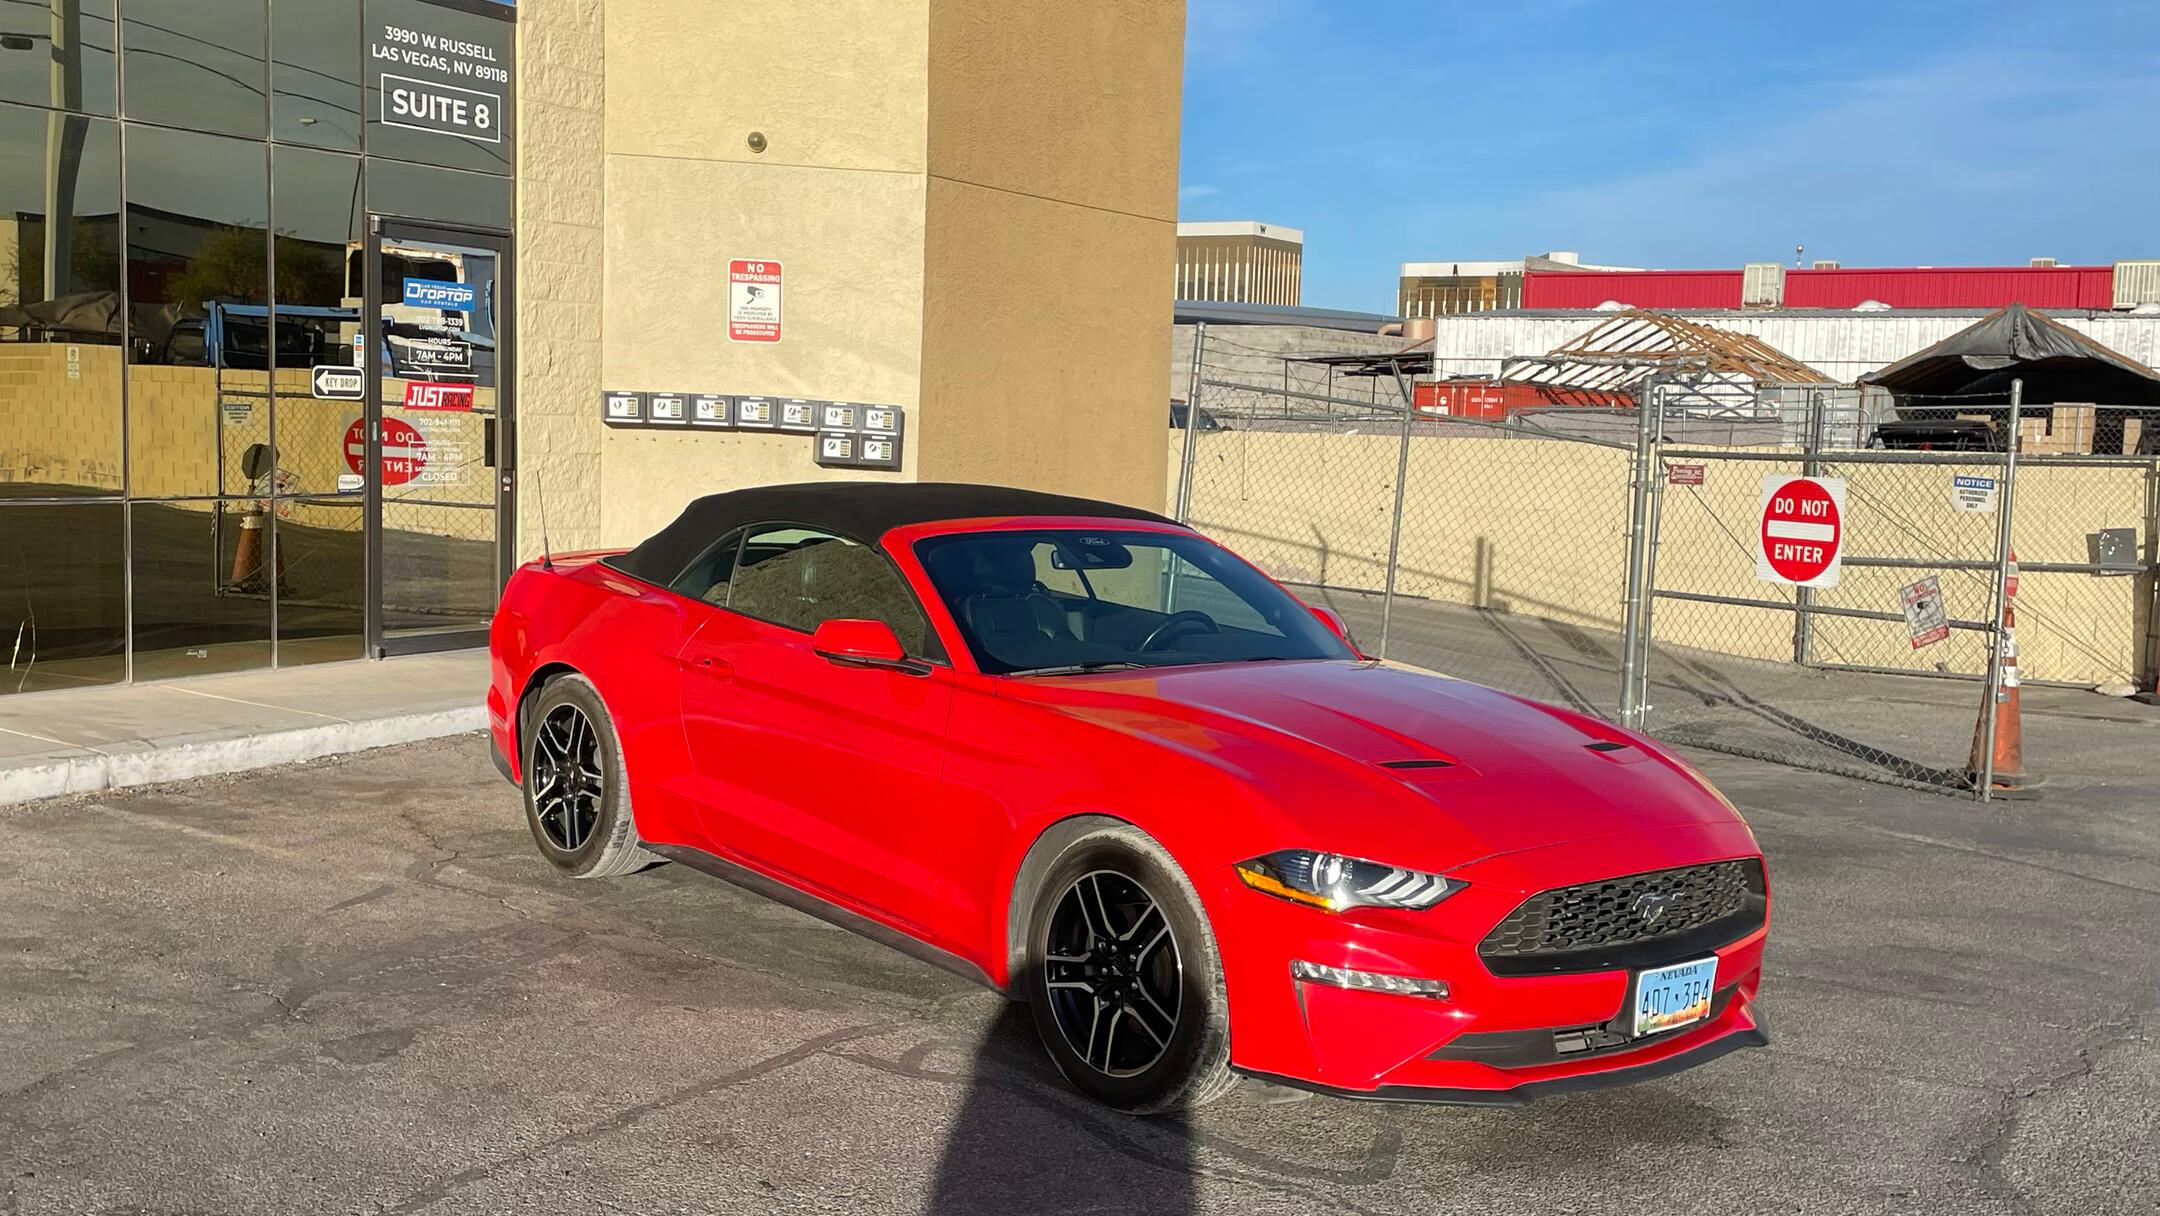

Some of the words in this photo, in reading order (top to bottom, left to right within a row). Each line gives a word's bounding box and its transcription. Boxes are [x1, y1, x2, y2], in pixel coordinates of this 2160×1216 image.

[384, 25, 418, 45] 3990
[439, 37, 497, 62] RUSSELL
[371, 43, 399, 62] LAS
[401, 49, 451, 75] VEGAS,
[453, 60, 473, 76] NV
[475, 65, 508, 84] 89118
[392, 88, 468, 126] SUITE
[474, 103, 490, 129] 8
[1259, 224, 1267, 235] W
[747, 263, 765, 273] NO
[731, 273, 780, 283] TRESPASSING
[428, 337, 452, 346] HOURS
[416, 350, 436, 361] 7AM
[442, 352, 463, 362] 4PM
[325, 377, 338, 388] KEY
[340, 377, 358, 389] DROP
[407, 385, 458, 408] JUST
[442, 391, 471, 408] RACING
[416, 453, 436, 462] 7AM
[443, 453, 463, 462] 4PM
[422, 472, 458, 482] CLOSED
[1956, 478, 1993, 488] NOTICE
[1959, 489, 1988, 497] AUTHORIZED
[1959, 495, 1986, 504] PERSONNEL
[1775, 497, 1795, 515] DO
[1801, 499, 1830, 517] NOT
[1774, 543, 1824, 564] ENTER
[1660, 965, 1698, 982] NEVADA
